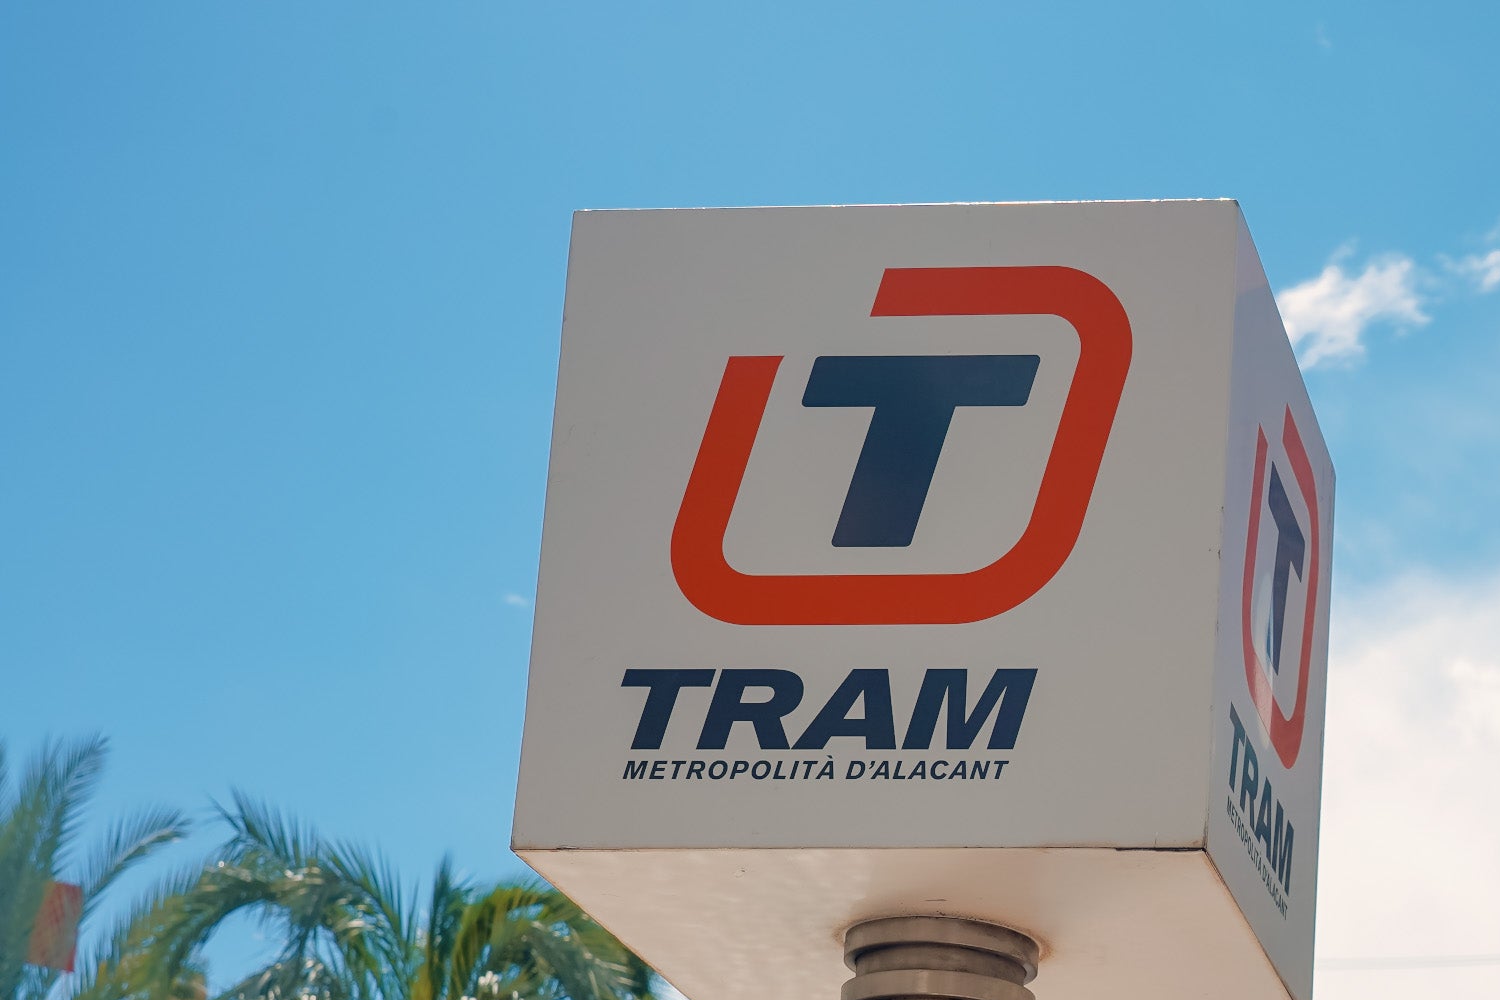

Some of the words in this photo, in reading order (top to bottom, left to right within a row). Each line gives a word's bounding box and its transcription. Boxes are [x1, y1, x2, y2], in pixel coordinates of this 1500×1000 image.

[621, 668, 1038, 750] TRAM
[622, 754, 835, 780] METROPOLITÀ
[846, 759, 1010, 780] D’ALACANT
[1228, 700, 1295, 897] TRAM
[1226, 795, 1263, 873] METROPOLITÀ
